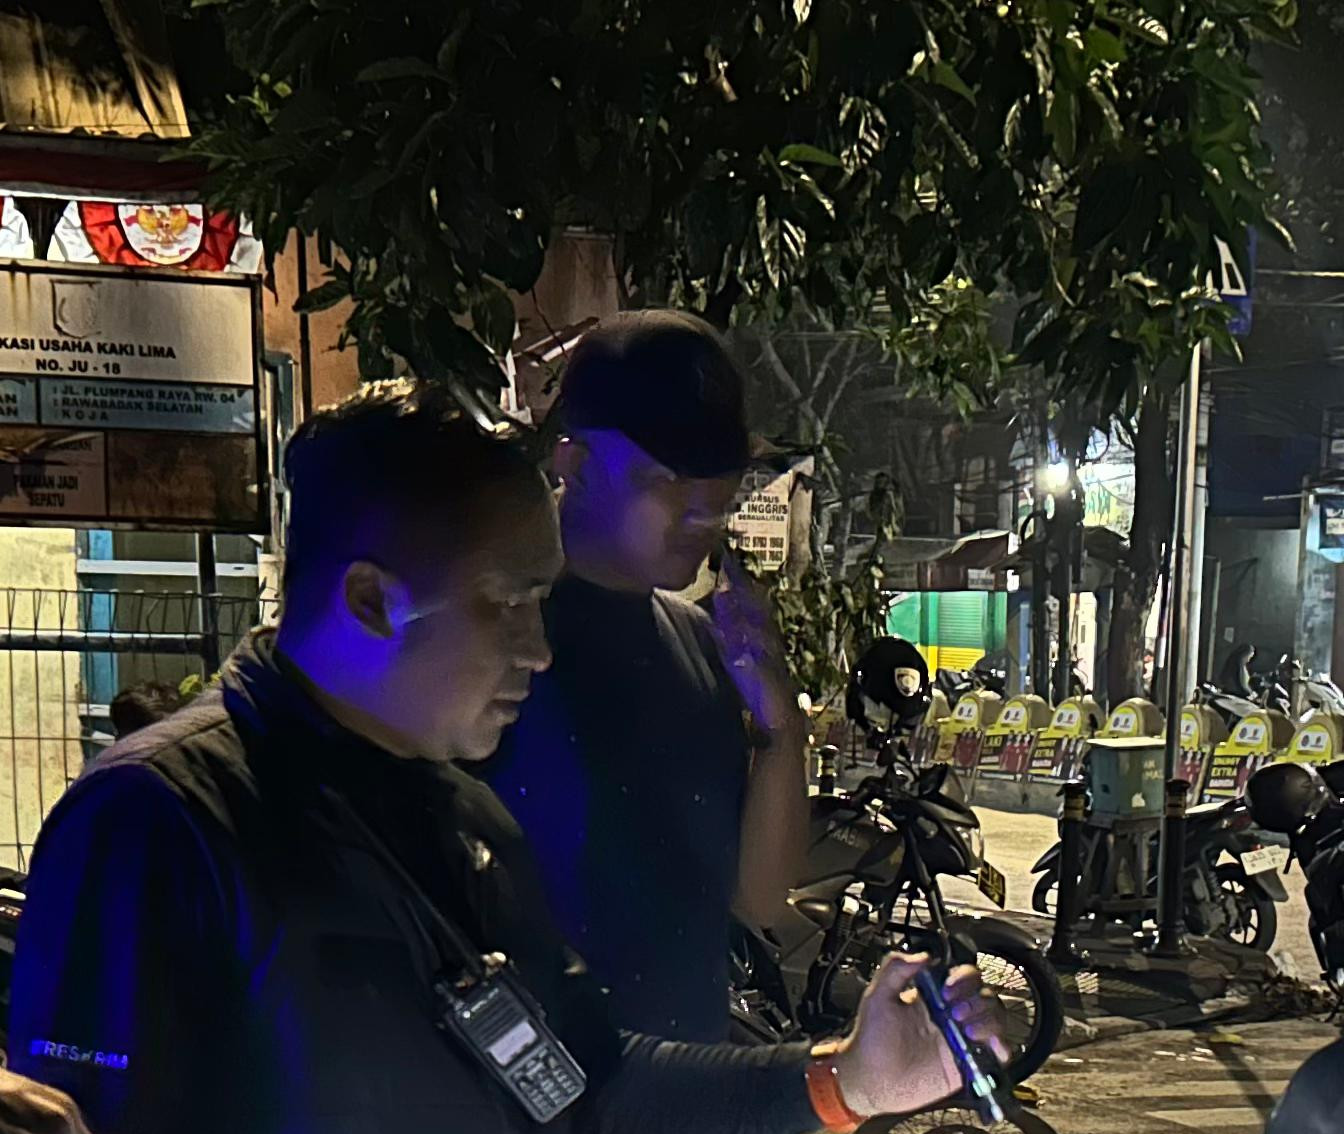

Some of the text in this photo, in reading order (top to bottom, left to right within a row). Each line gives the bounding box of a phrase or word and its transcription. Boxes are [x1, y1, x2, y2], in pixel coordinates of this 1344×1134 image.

[39, 339, 94, 353] USAHA
[97, 342, 135, 355] KAKI
[138, 345, 176, 359] LIMA
[36, 358, 63, 372] NO.
[68, 360, 88, 373] JU
[103, 362, 121, 375] 18
[62, 385, 79, 396] JL.
[85, 386, 154, 399] PLUMPANG
[158, 389, 189, 401] RAYA
[147, 401, 203, 415] SELATAN
[748, 503, 788, 514] INGGRIS
[1211, 766, 1237, 777] EXTRA
